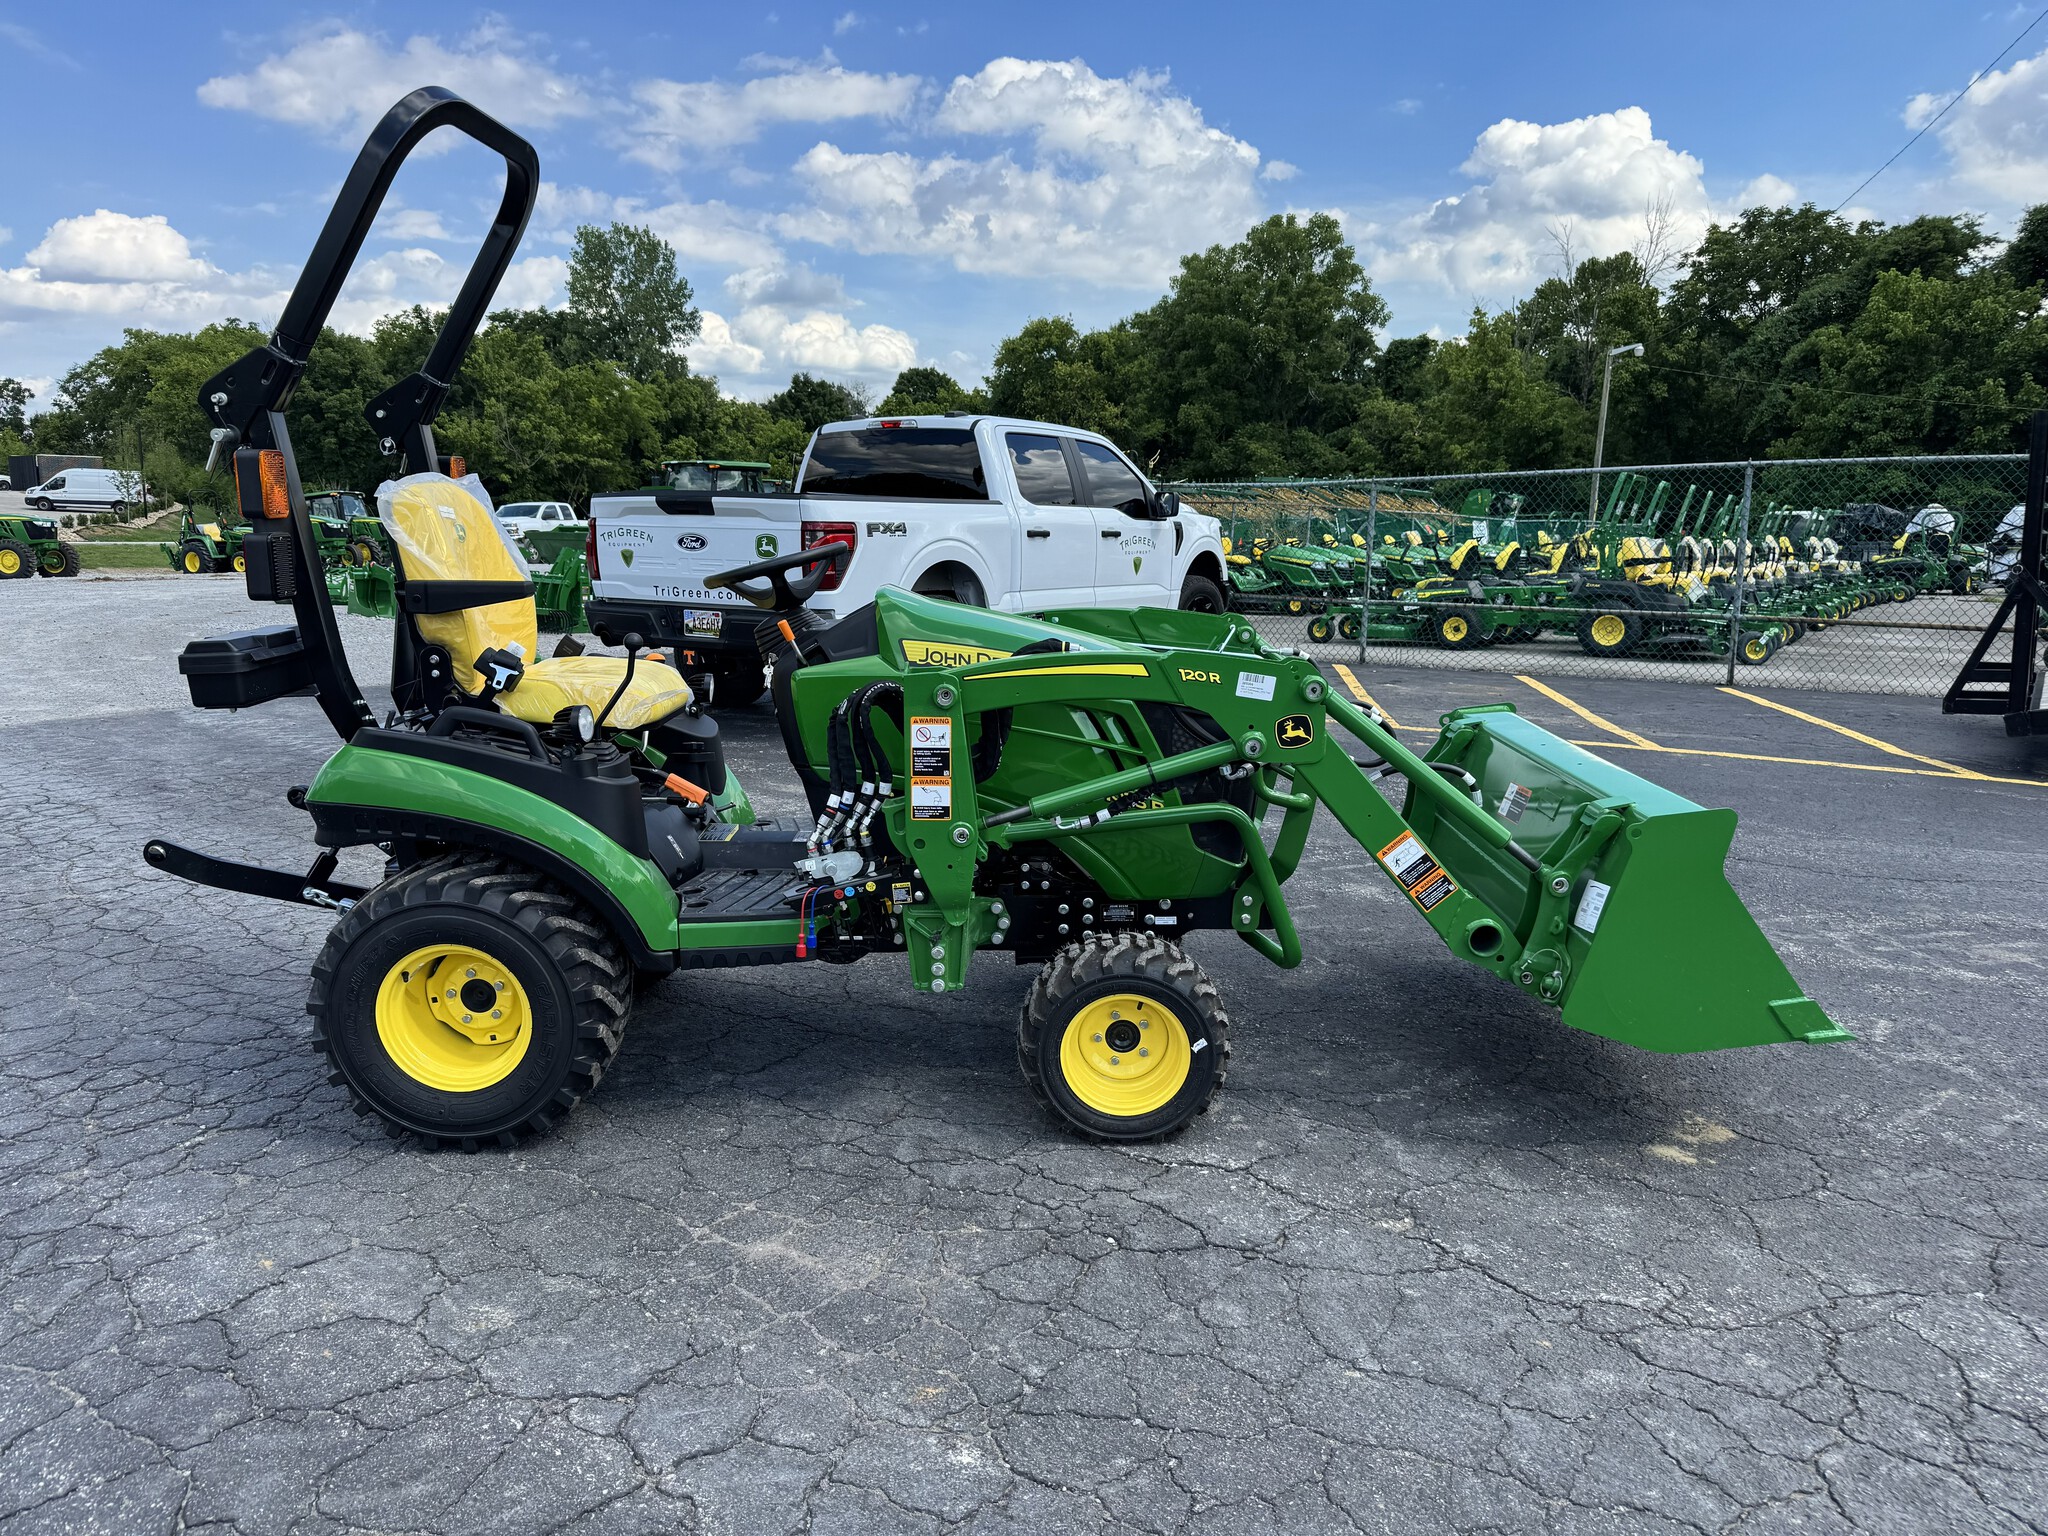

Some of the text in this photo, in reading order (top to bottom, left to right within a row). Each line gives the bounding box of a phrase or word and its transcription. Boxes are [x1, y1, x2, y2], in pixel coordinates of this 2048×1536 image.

[866, 522, 907, 537] FX4
[681, 537, 702, 549] Ford
[684, 650, 695, 665] T
[919, 647, 971, 666] JOHN
[1178, 668, 1221, 684] 120 R
[1387, 834, 1408, 852] WARNING
[1420, 872, 1442, 890] WARNING
